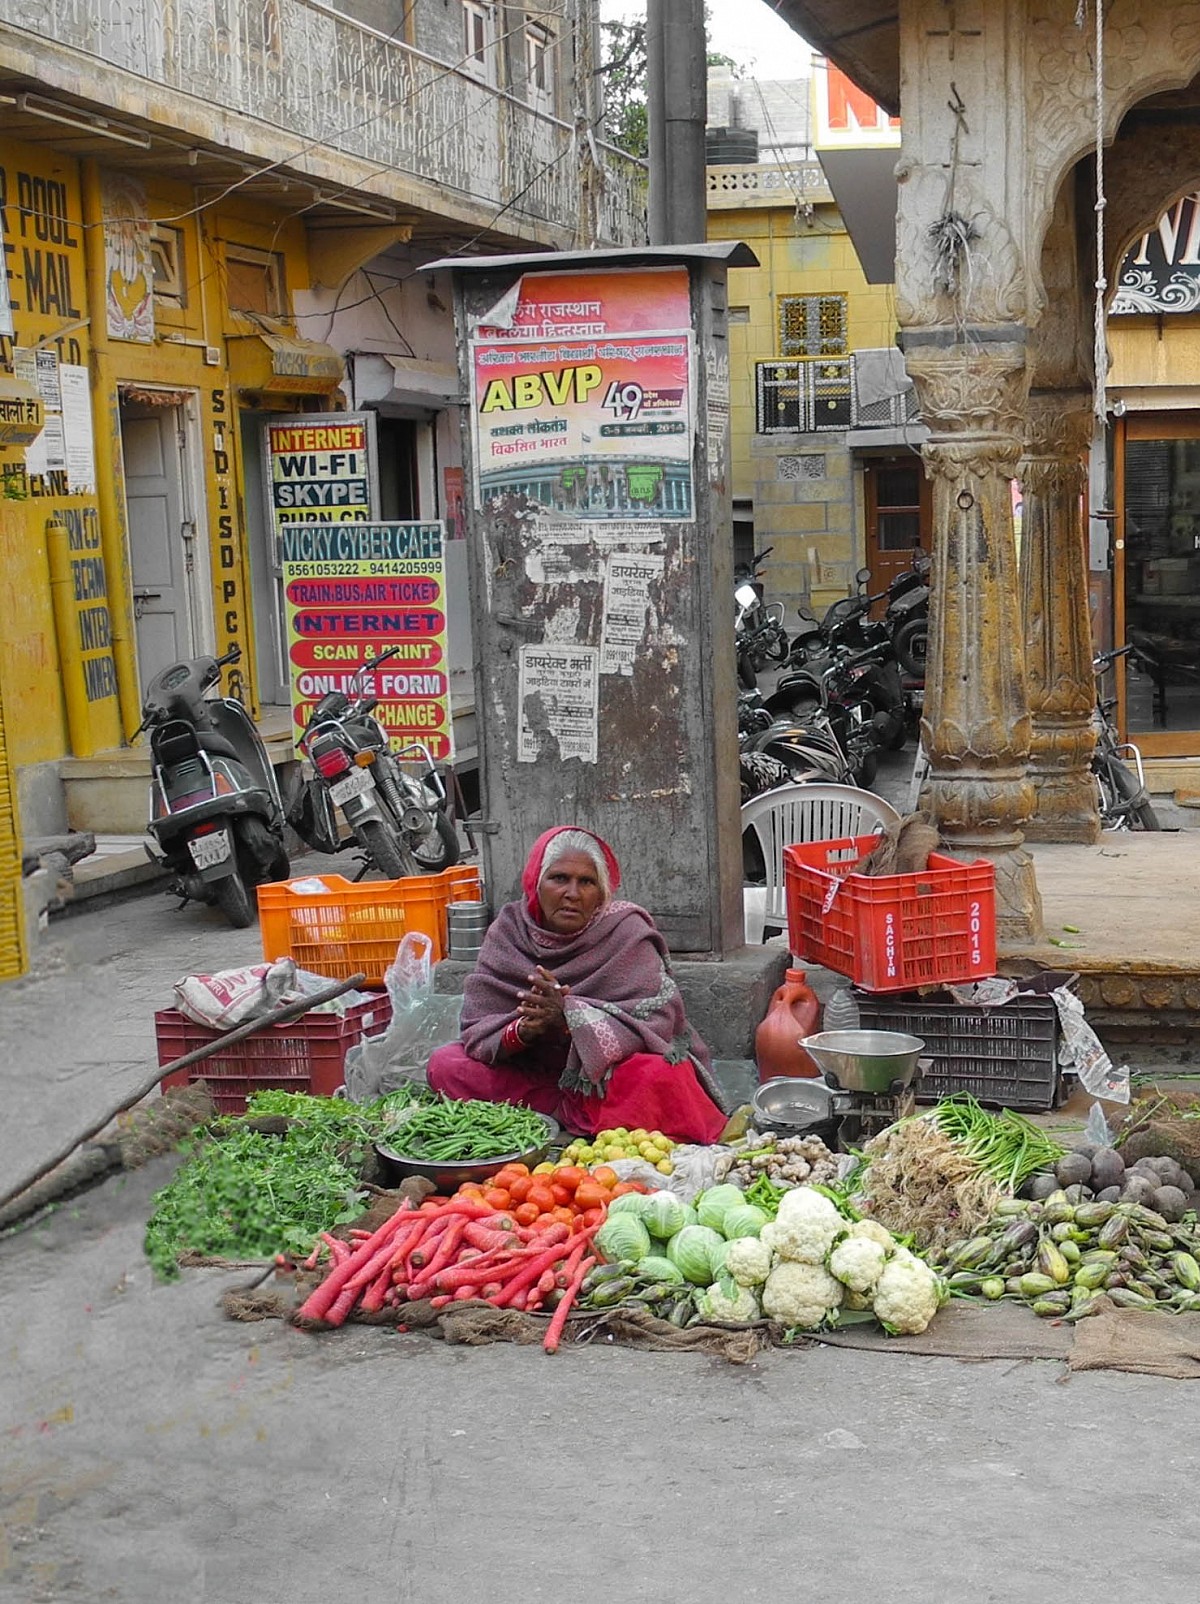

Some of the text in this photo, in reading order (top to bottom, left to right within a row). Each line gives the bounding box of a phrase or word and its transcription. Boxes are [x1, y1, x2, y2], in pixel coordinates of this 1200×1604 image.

[17, 172, 77, 248] POOL
[481, 366, 602, 412] ABVP
[602, 381, 642, 420] 49
[272, 428, 363, 450] INTERNET
[492, 437, 568, 456] विकसित भारत
[278, 453, 357, 477] WI-FI
[278, 482, 365, 507] SKYPE
[284, 526, 440, 561] VICKY CYBER CAFE
[288, 563, 359, 576] 8561053222
[370, 561, 442, 574] 9414205999
[390, 583, 439, 600] TICKET
[293, 614, 438, 632] INTERNET
[313, 644, 432, 659] SCAN & PRINT
[300, 675, 440, 694] ONLINE FORM
[886, 913, 896, 977] SACHIN
[970, 902, 981, 964] 2015
